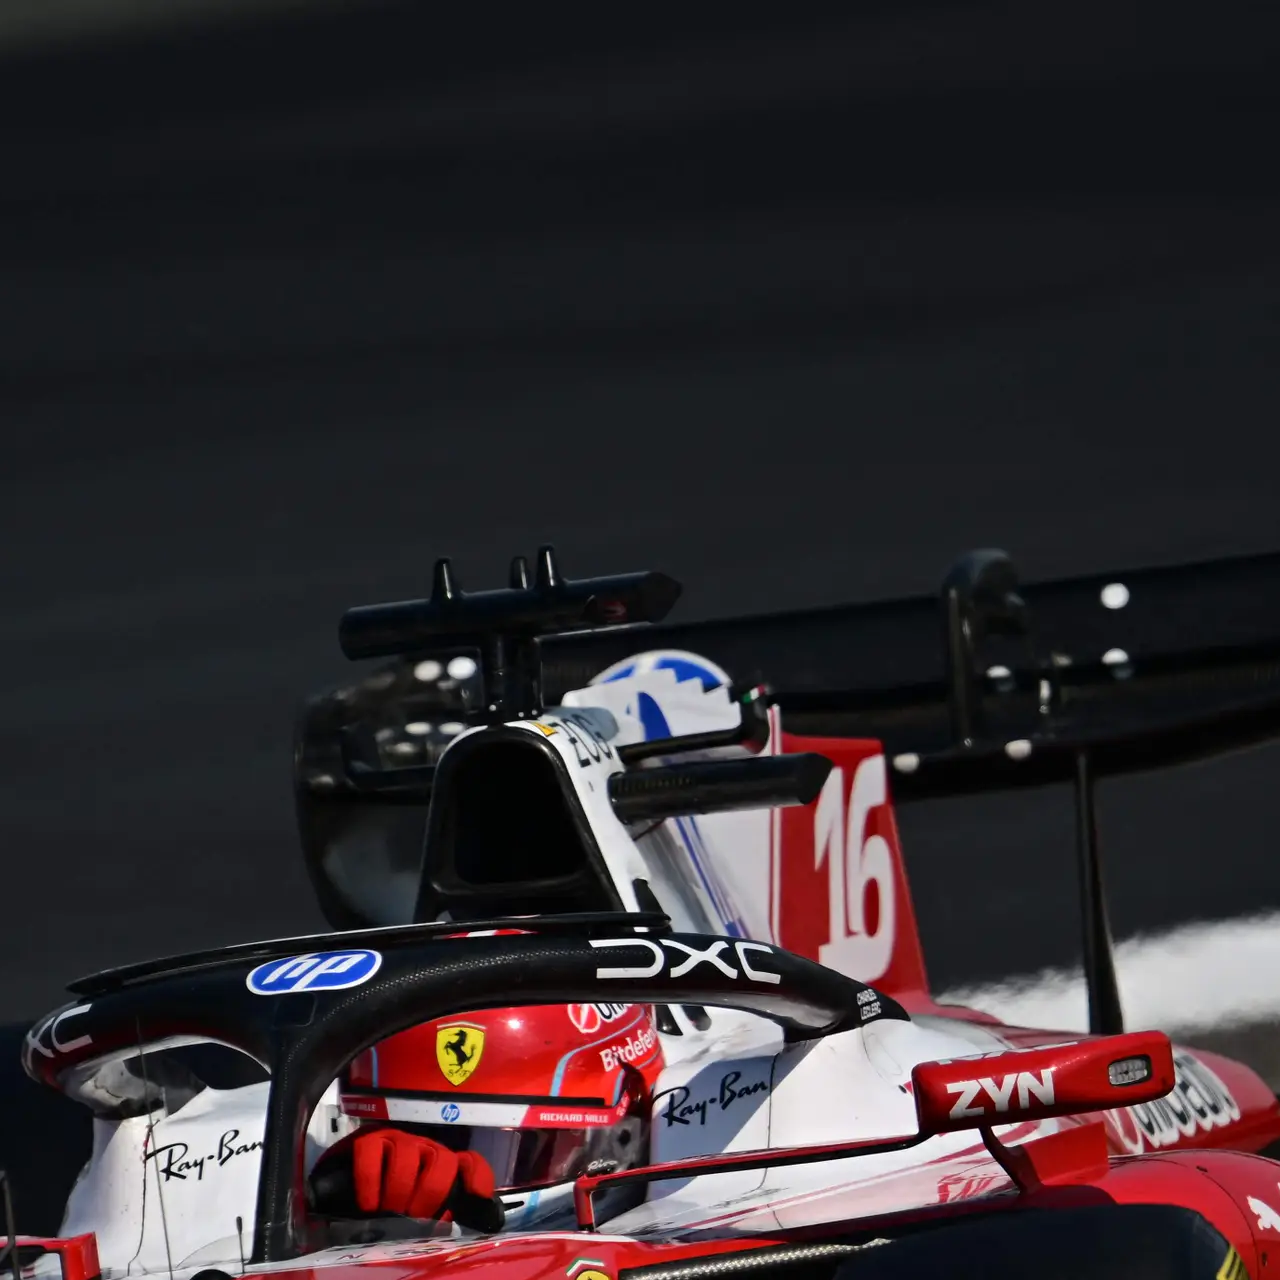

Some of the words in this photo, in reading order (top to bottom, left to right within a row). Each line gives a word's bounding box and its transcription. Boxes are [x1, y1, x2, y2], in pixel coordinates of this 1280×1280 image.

[812, 752, 896, 983] 16
[255, 951, 370, 993] hp
[589, 938, 783, 985] DXC
[24, 1003, 94, 1069] XC
[599, 1027, 656, 1073] Bitdefe
[441, 1104, 460, 1122] hp
[539, 1113, 583, 1123] RICHARD
[585, 1114, 609, 1124] MILLE
[652, 1070, 769, 1128] Ray-Ban
[946, 1069, 1055, 1121] ZYN
